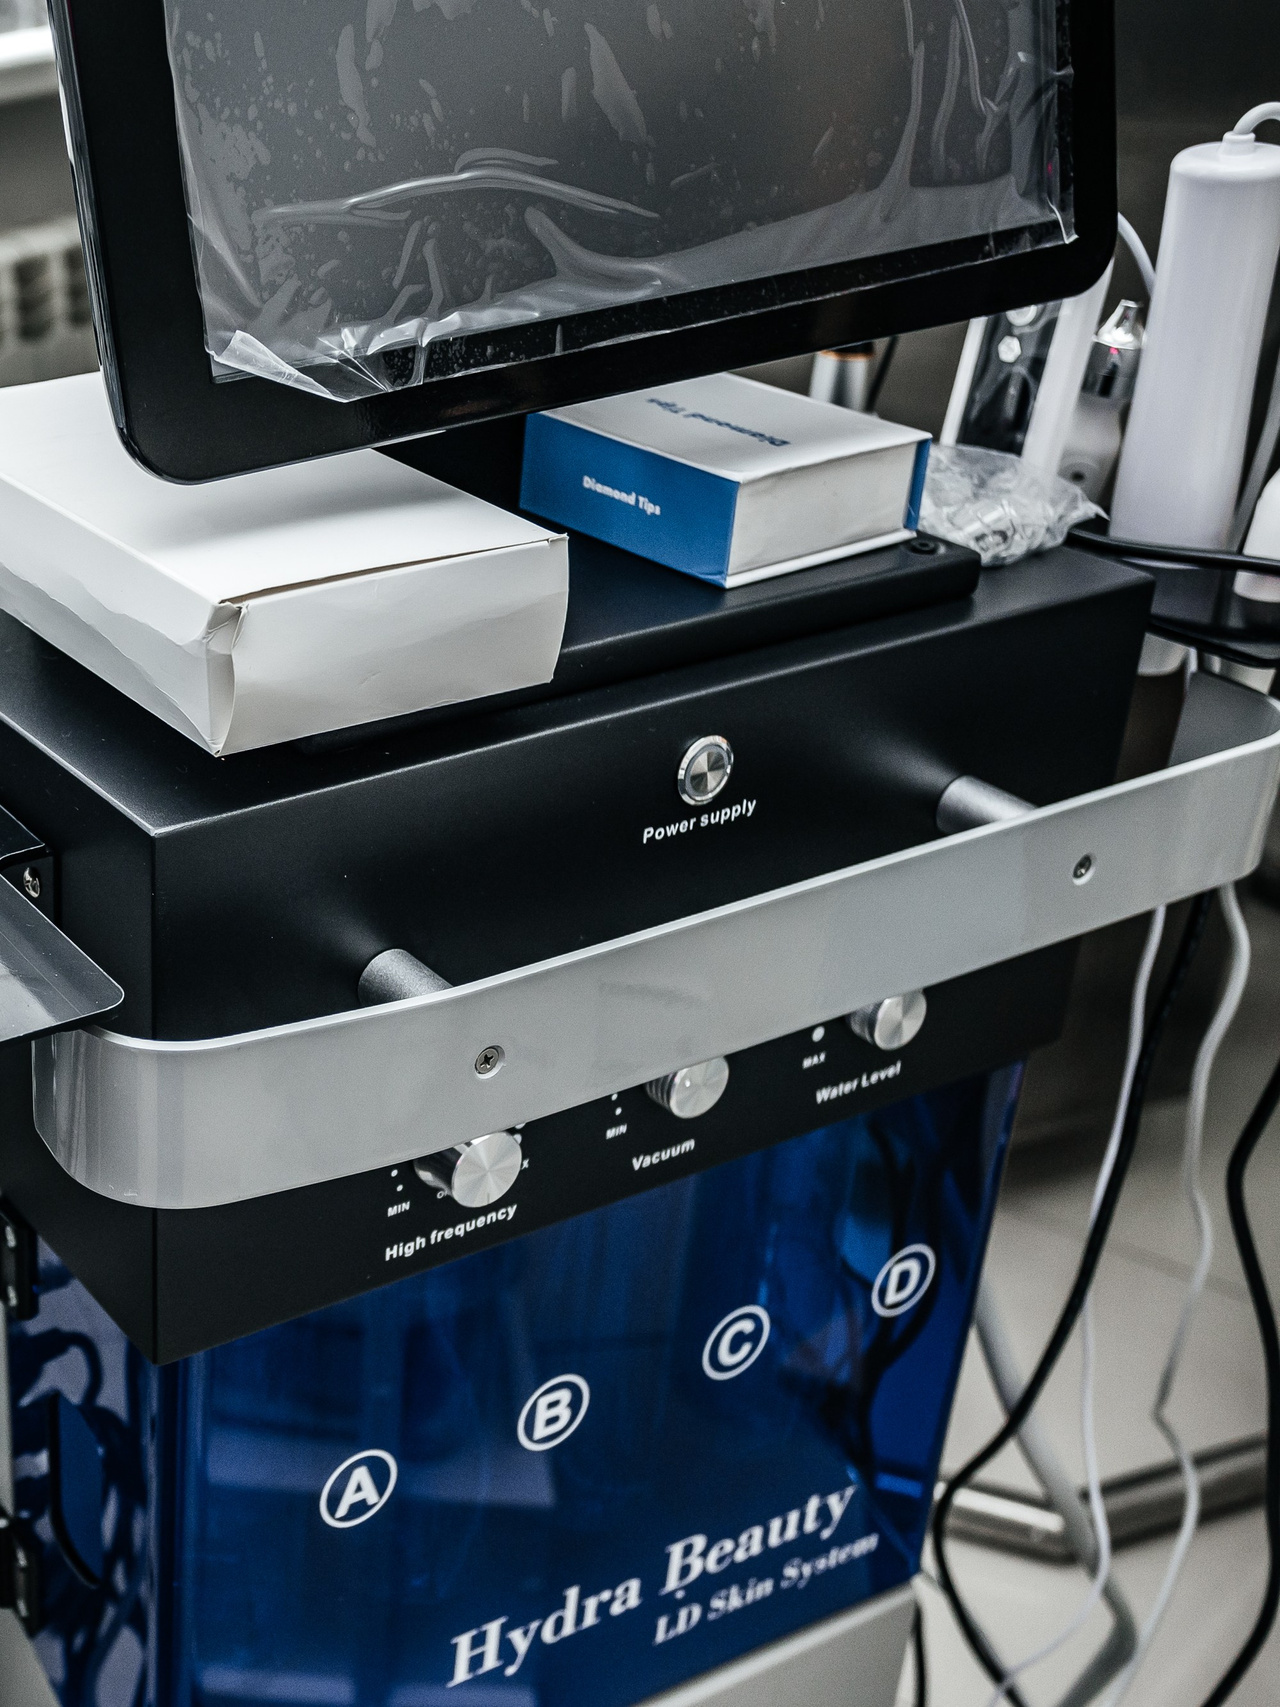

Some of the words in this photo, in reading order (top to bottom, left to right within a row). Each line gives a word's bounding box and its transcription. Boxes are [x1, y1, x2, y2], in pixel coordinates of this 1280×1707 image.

[582, 475, 637, 506] Diamond
[638, 495, 661, 516] Tips
[642, 817, 697, 844] Power
[700, 798, 757, 828] supply
[816, 1077, 860, 1105] Water
[861, 1059, 902, 1089] Level
[605, 1123, 628, 1140] MIN
[632, 1138, 696, 1171] Vacuum
[387, 1201, 411, 1217] MIN
[384, 1236, 426, 1261] High
[430, 1204, 518, 1245] frequency
[445, 1577, 643, 1688] Hydra
[659, 1484, 858, 1597] Beauty
[653, 1602, 703, 1646] LD
[707, 1577, 775, 1621] Skin
